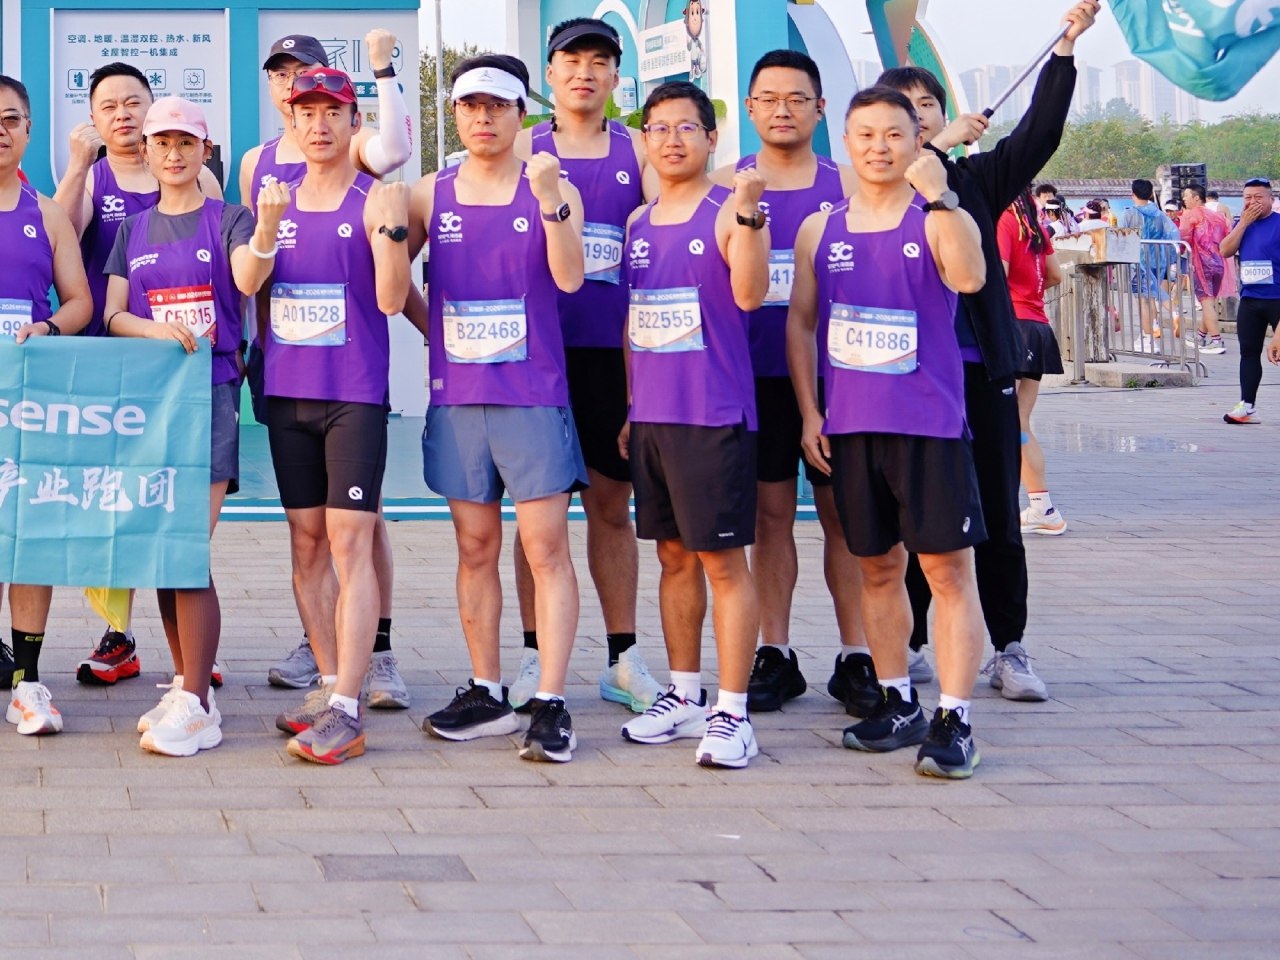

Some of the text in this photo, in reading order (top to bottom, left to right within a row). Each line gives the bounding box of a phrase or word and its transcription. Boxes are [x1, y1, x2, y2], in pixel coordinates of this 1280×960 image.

[101, 48, 178, 57] 全屋智控一机集成
[282, 304, 340, 323] A01528
[638, 309, 694, 329] B22555
[457, 321, 520, 340] B22468
[846, 327, 910, 351] C41886
